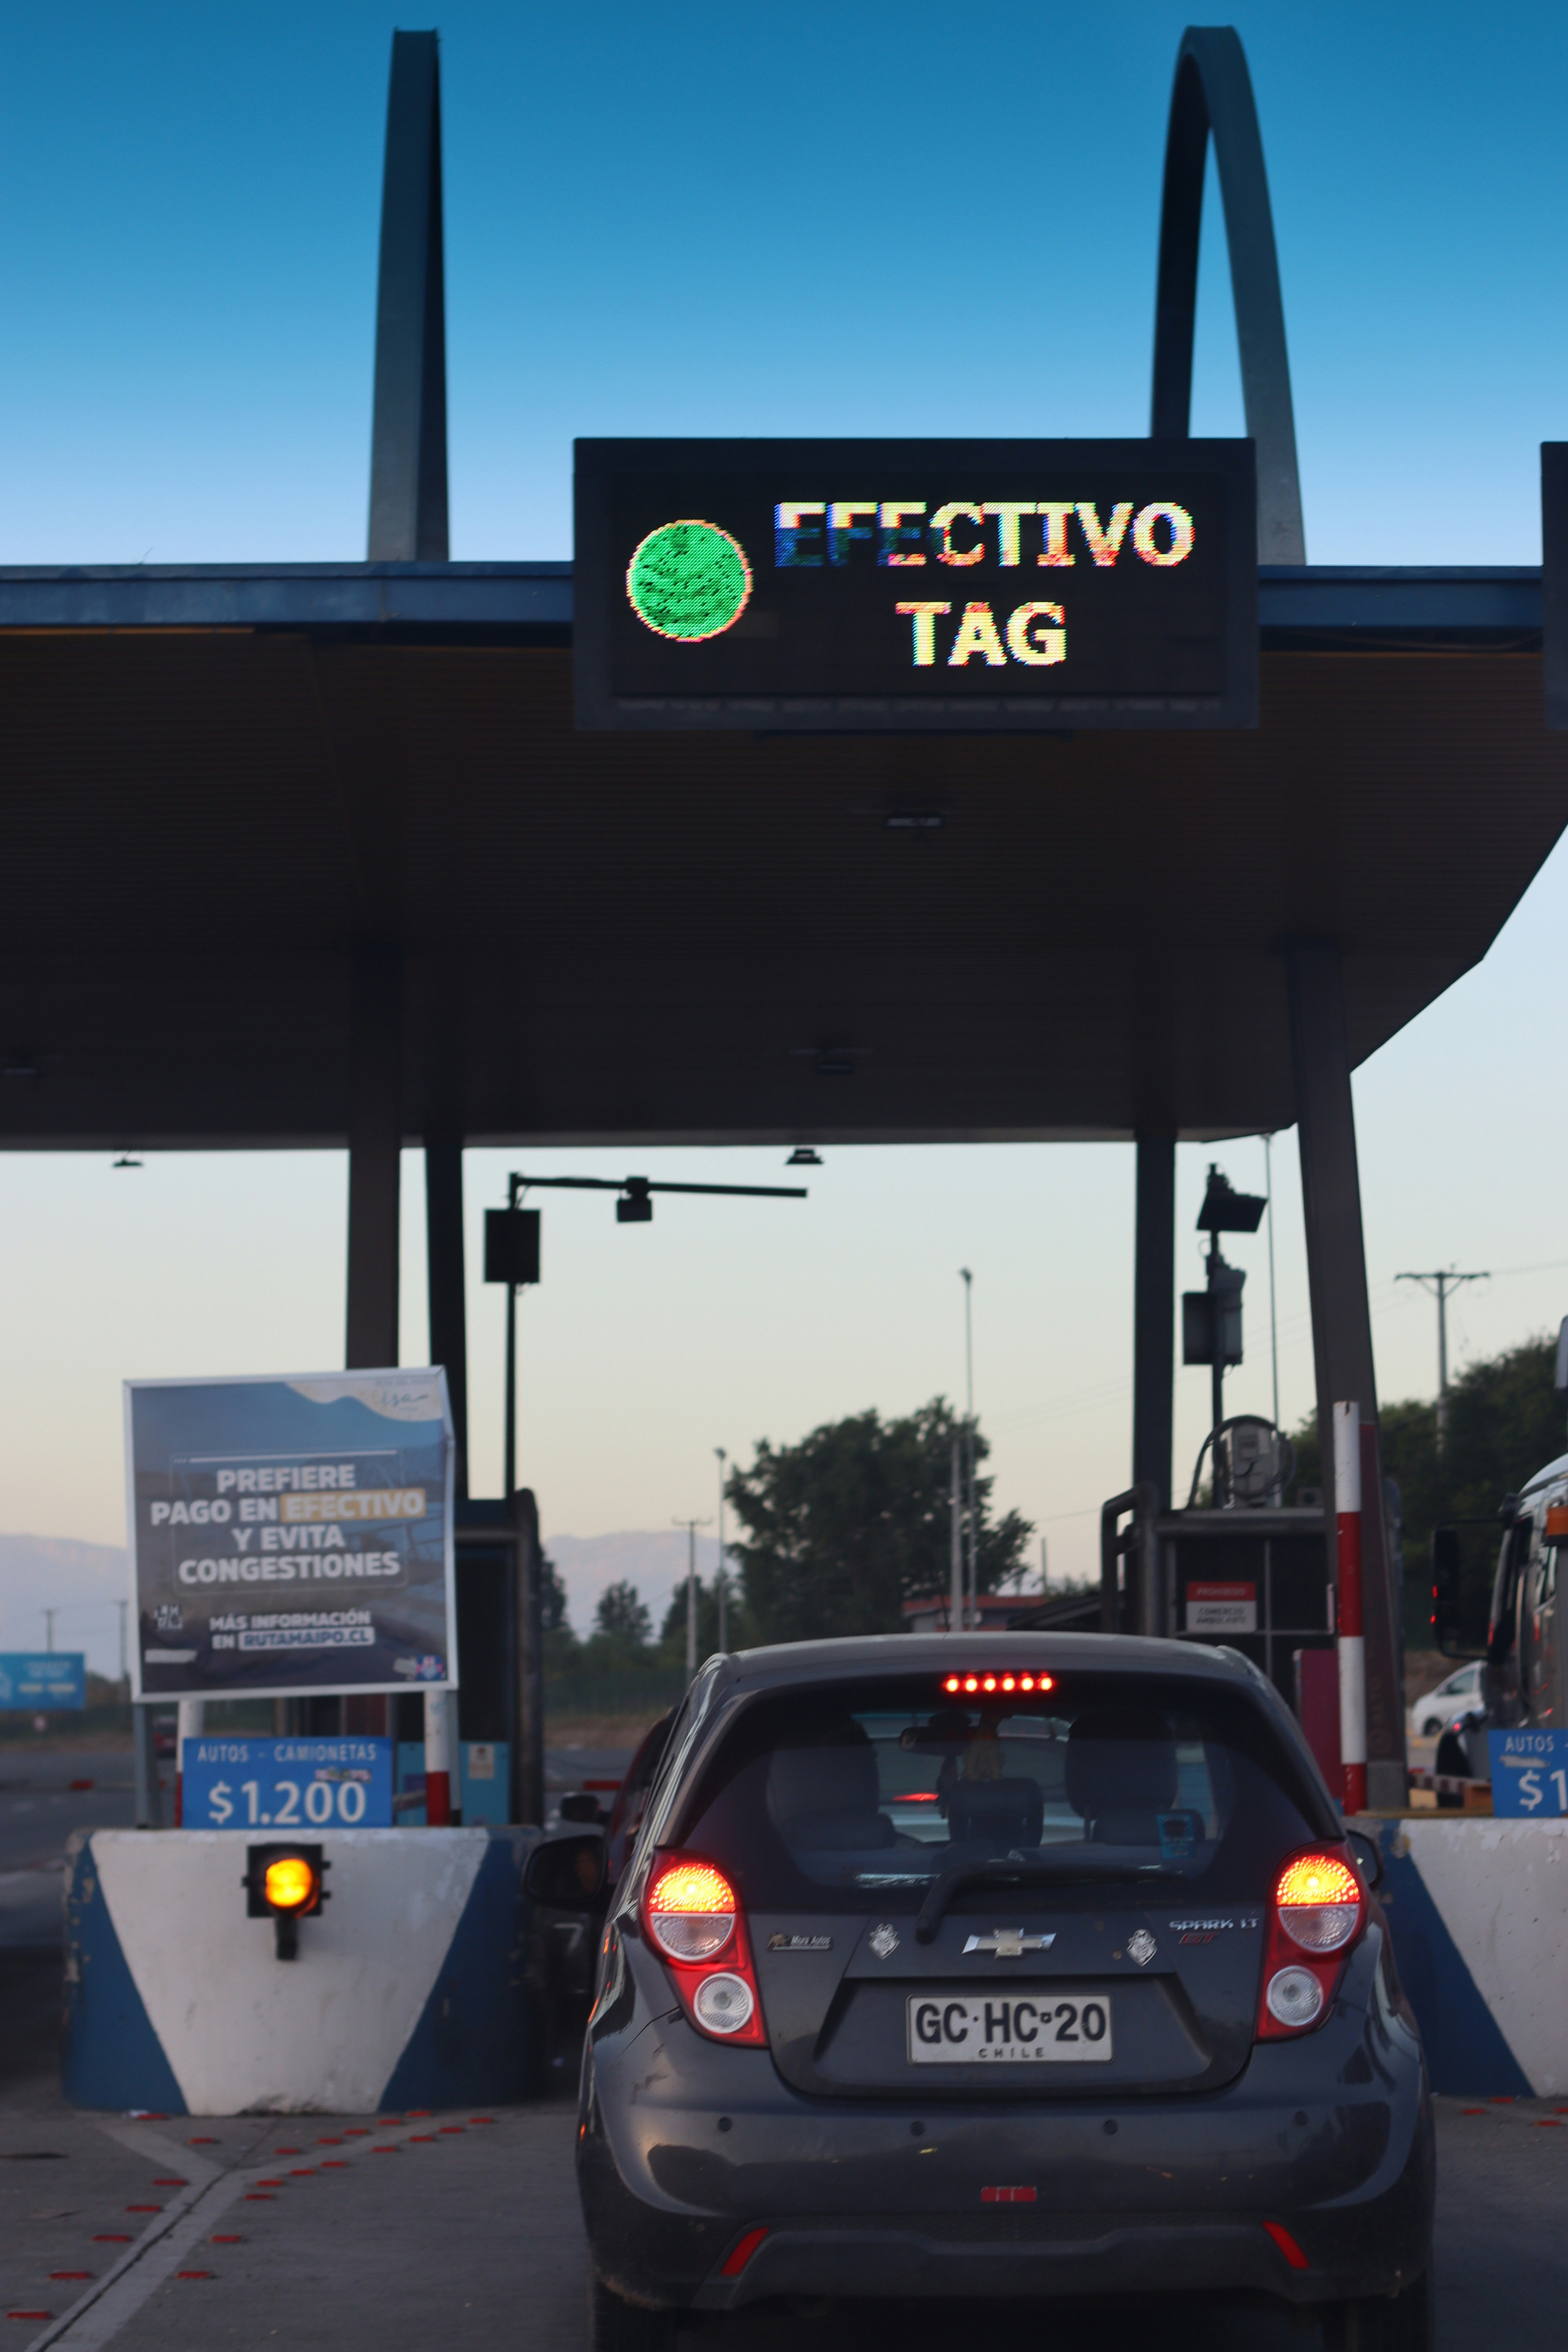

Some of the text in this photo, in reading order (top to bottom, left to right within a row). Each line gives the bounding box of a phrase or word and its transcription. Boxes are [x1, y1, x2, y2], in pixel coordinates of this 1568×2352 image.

[775, 502, 1196, 567] EFECTIVO
[895, 601, 1067, 666] TAG
[217, 1464, 356, 1494] PREFIERE
[151, 1492, 424, 1526] PAGO EN EFECTIVO
[232, 1524, 345, 1552] Y EVITA
[178, 1551, 400, 1584] CONGESTIONES
[211, 1608, 371, 1631] MÁS INFORMACIÓN
[212, 1629, 369, 1649] EN RUTAMAIPO.CL
[197, 1744, 249, 1762] AUTOS
[274, 1743, 376, 1762] CAMIONETAS
[1505, 1735, 1555, 1753] AUTOS
[209, 1780, 367, 1824] $1.200
[1169, 1919, 1234, 1931] SPARK
[978, 2047, 1045, 2058] CHILE
